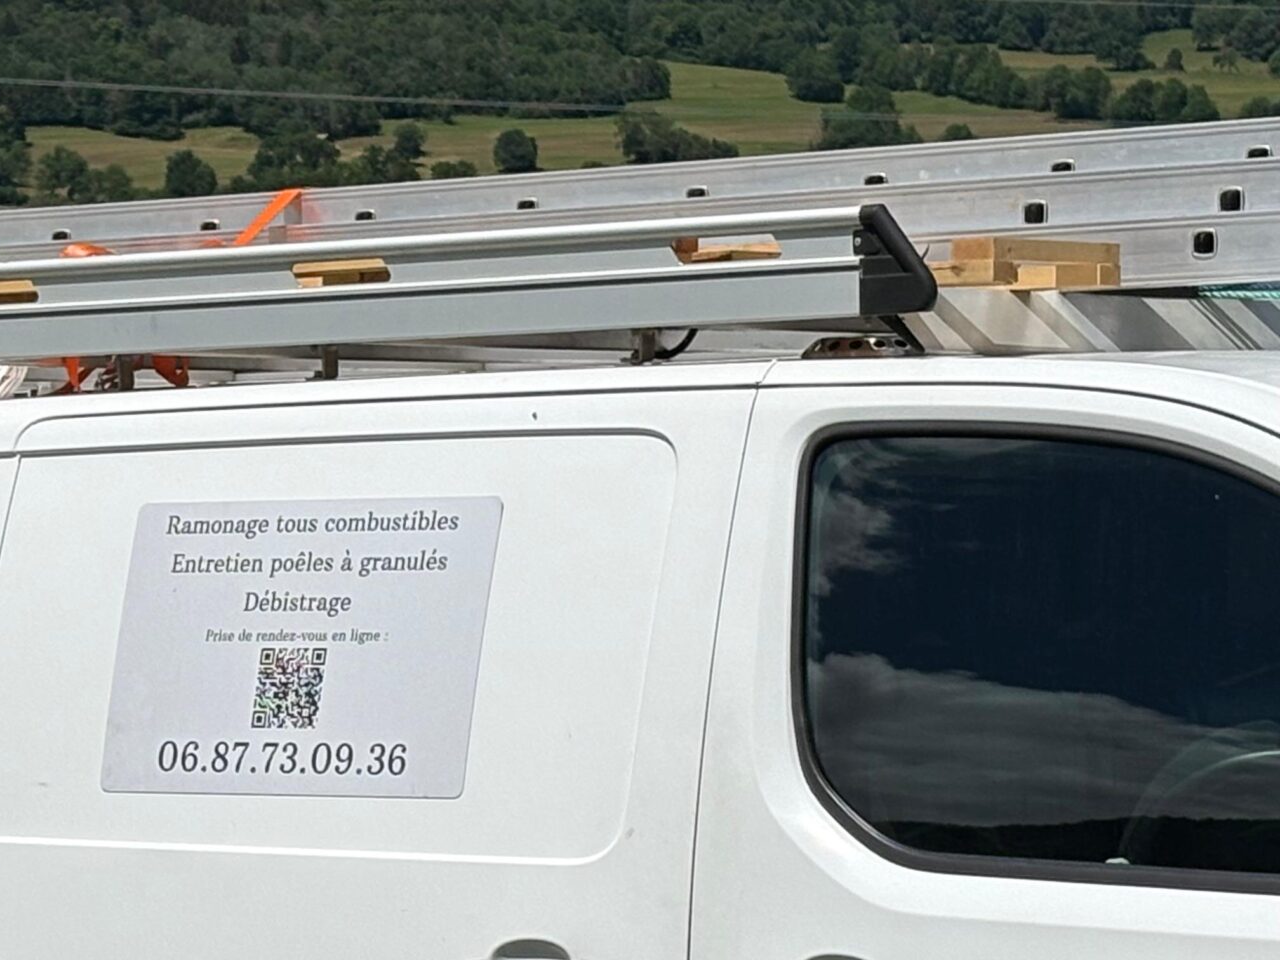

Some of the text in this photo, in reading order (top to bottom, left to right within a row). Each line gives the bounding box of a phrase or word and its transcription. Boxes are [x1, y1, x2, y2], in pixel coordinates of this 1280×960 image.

[166, 510, 460, 539] Ramonage tous combustibles
[171, 548, 448, 577] Entretien poêles à granulés
[243, 589, 352, 617] Débistrage
[205, 629, 235, 642] Prise
[238, 629, 253, 642] de
[256, 629, 328, 642] rendez-vous
[332, 632, 347, 642] en
[350, 629, 380, 645] ligne
[158, 740, 407, 776] 06.87.73.09.36
